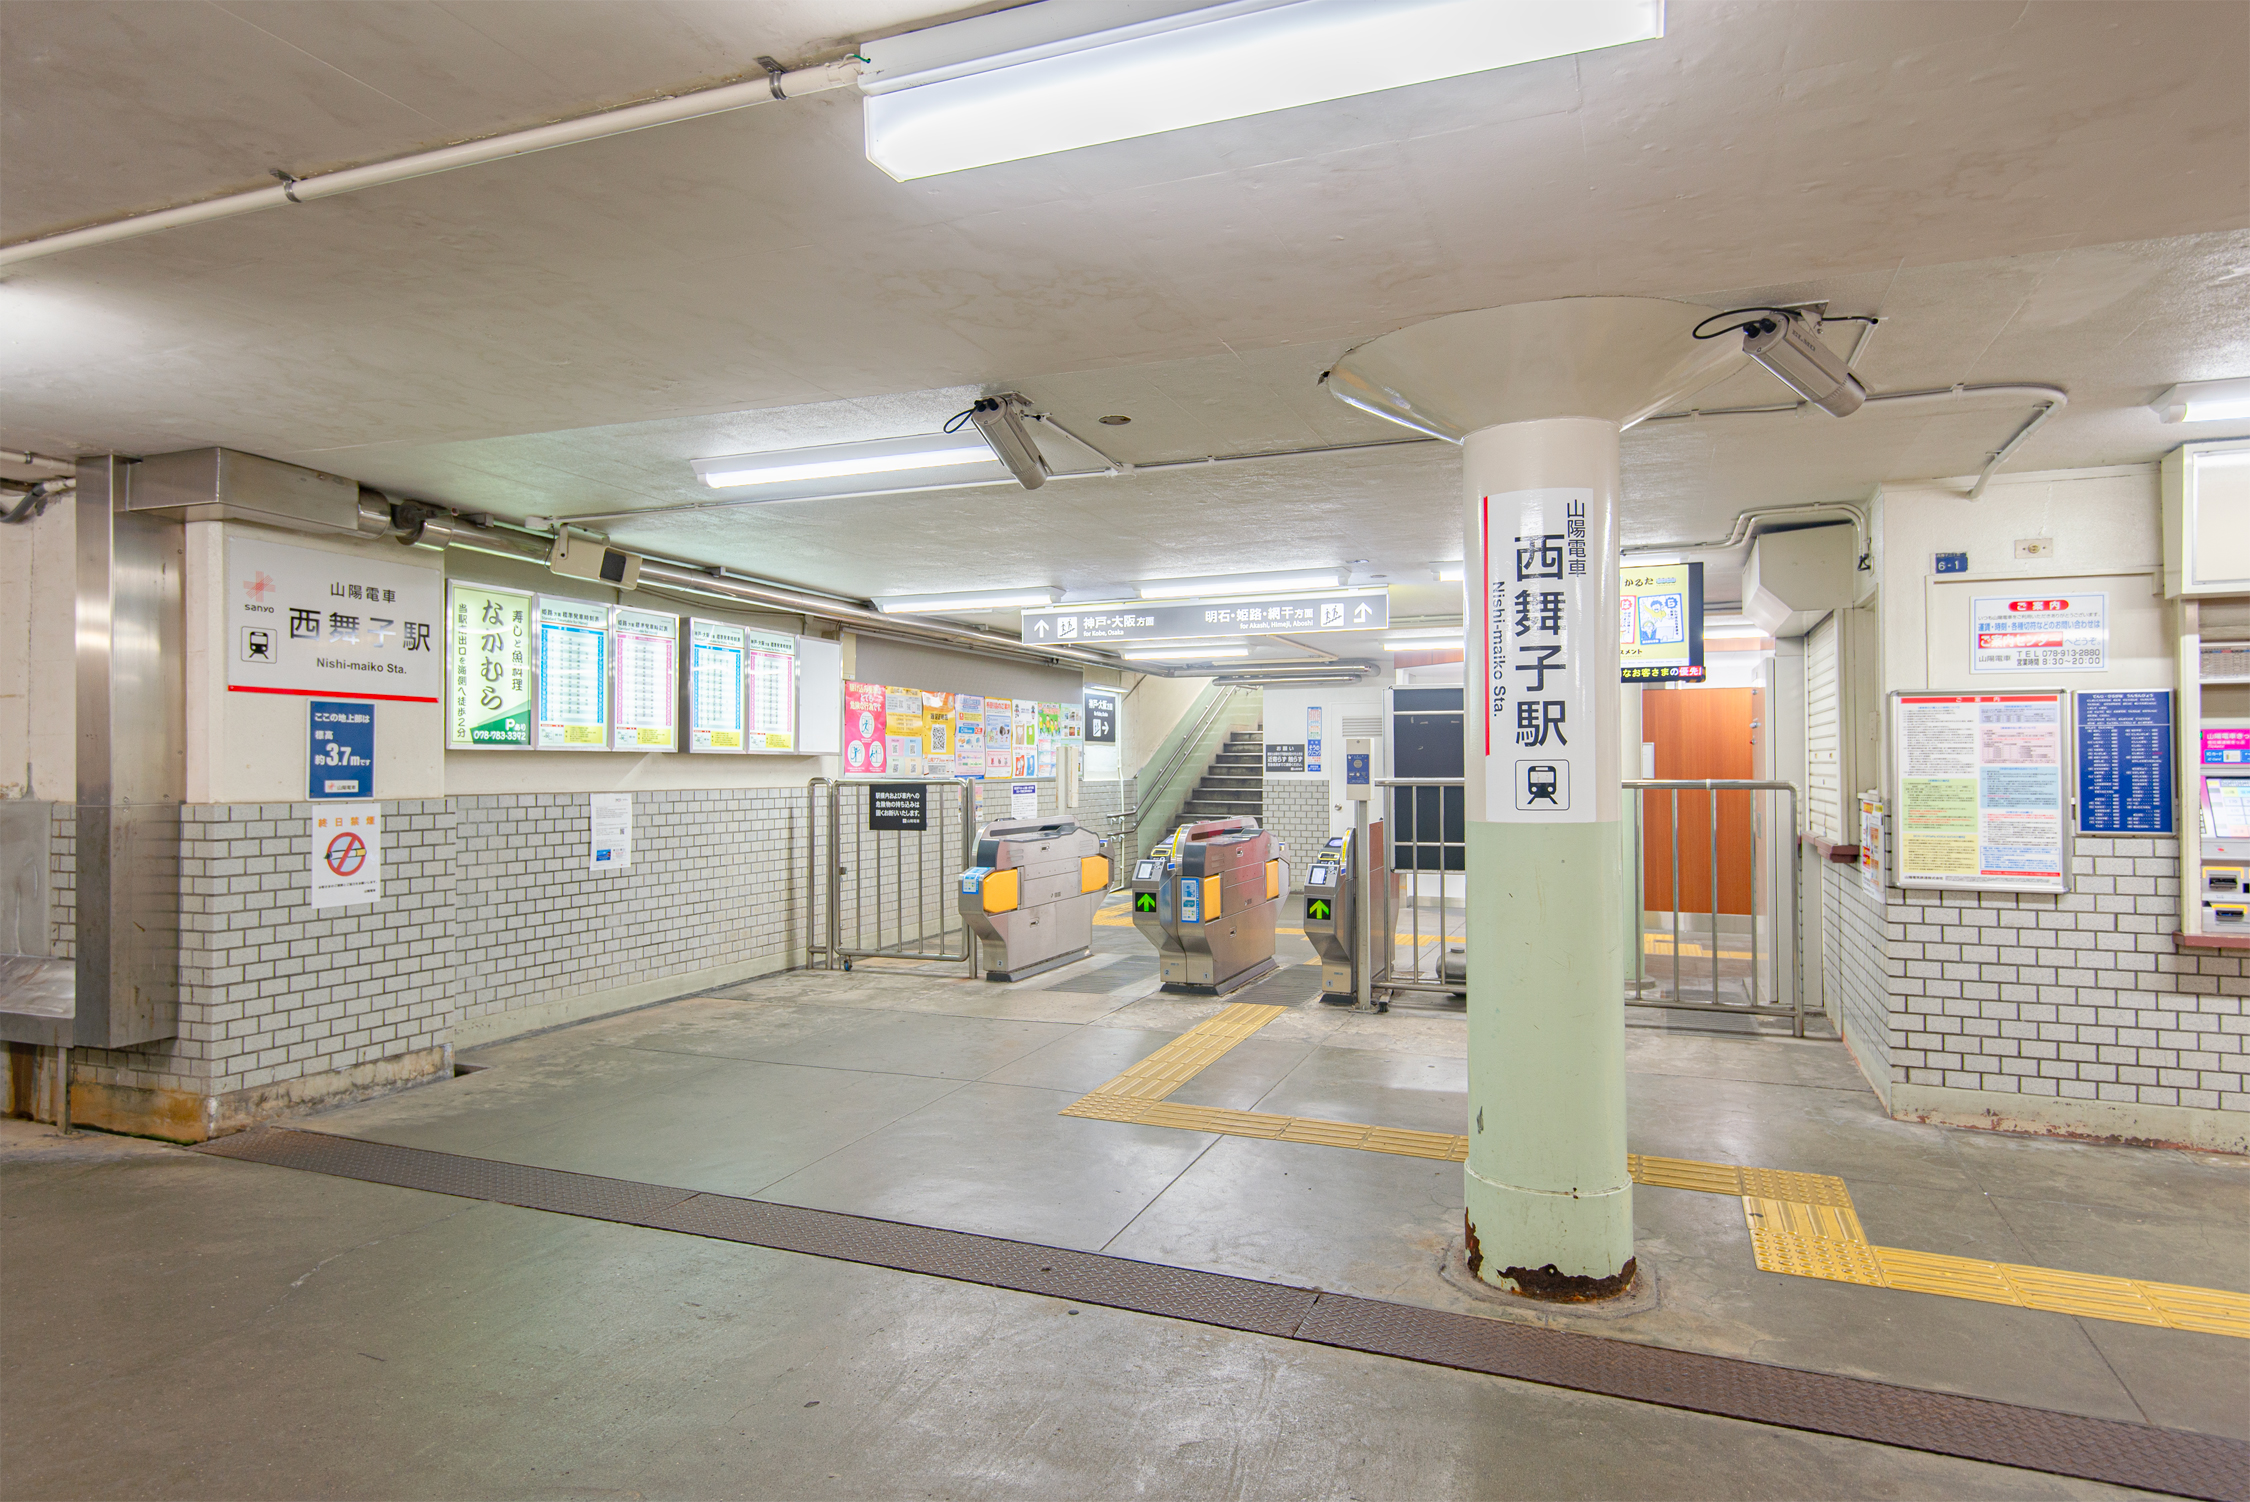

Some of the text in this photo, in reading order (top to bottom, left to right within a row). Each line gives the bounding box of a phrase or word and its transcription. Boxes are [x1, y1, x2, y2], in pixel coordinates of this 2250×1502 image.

[1566, 499, 1587, 577] 山陽電車
[1624, 577, 1654, 587] かるた
[330, 582, 396, 603] 山陽電車
[244, 603, 275, 614] sanyo
[2016, 600, 2061, 611] ご案内
[1205, 606, 1314, 623] 明石・姫路・網干方面
[1083, 614, 1155, 629] 神戸・大阪方面
[1270, 620, 1292, 629] Himeji,
[1292, 619, 1313, 627] Aboshi
[1978, 620, 2101, 632] 運賃・時刻・各種切符などのお問い合わせは
[289, 607, 431, 652] 西舞子駅
[1514, 533, 1568, 747] 西舞子駅
[480, 599, 505, 711] なかむら
[512, 610, 523, 691] 寿しと魚料理
[1492, 580, 1507, 717] Nishi-maiko Sta.
[2042, 648, 2100, 657] 078-913-2880
[317, 657, 407, 674] Nishi-maiko Sta.
[1622, 666, 1702, 678] なお客さまの優先
[314, 712, 370, 723] ここの地上部は
[473, 730, 526, 741] 078-783-3392
[318, 816, 375, 828] 終日禁煙
